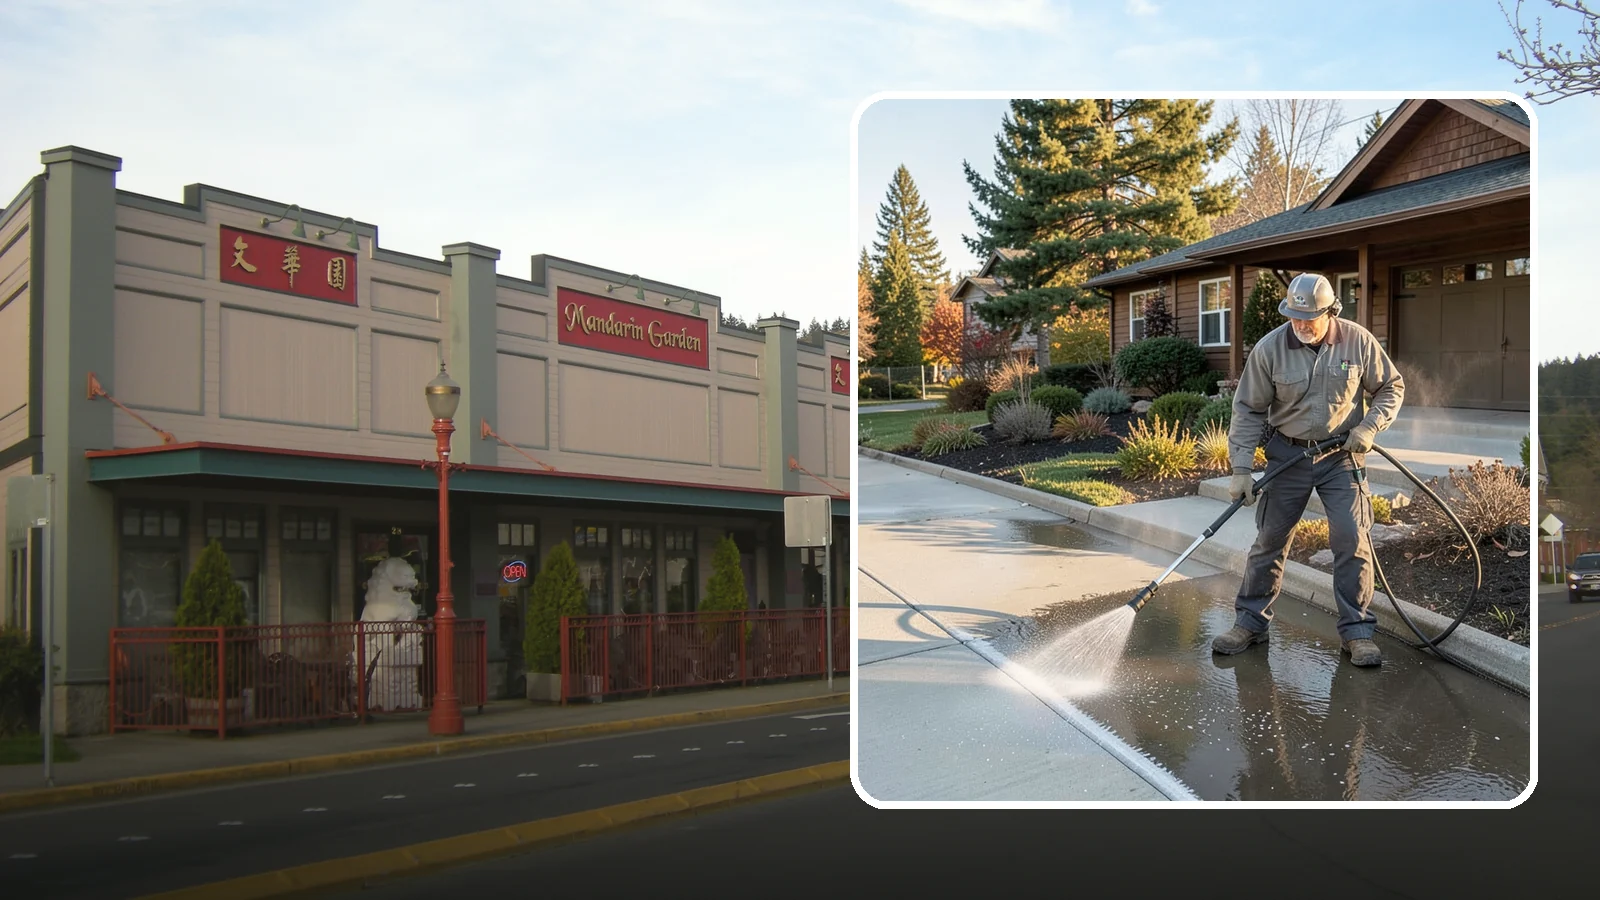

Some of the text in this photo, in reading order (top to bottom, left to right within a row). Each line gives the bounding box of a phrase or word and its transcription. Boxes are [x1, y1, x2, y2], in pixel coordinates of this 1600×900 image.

[231, 235, 346, 291] 文華園
[564, 302, 701, 352] Mandarin Garden
[834, 363, 846, 386] 文
[503, 565, 527, 578] OPEN
